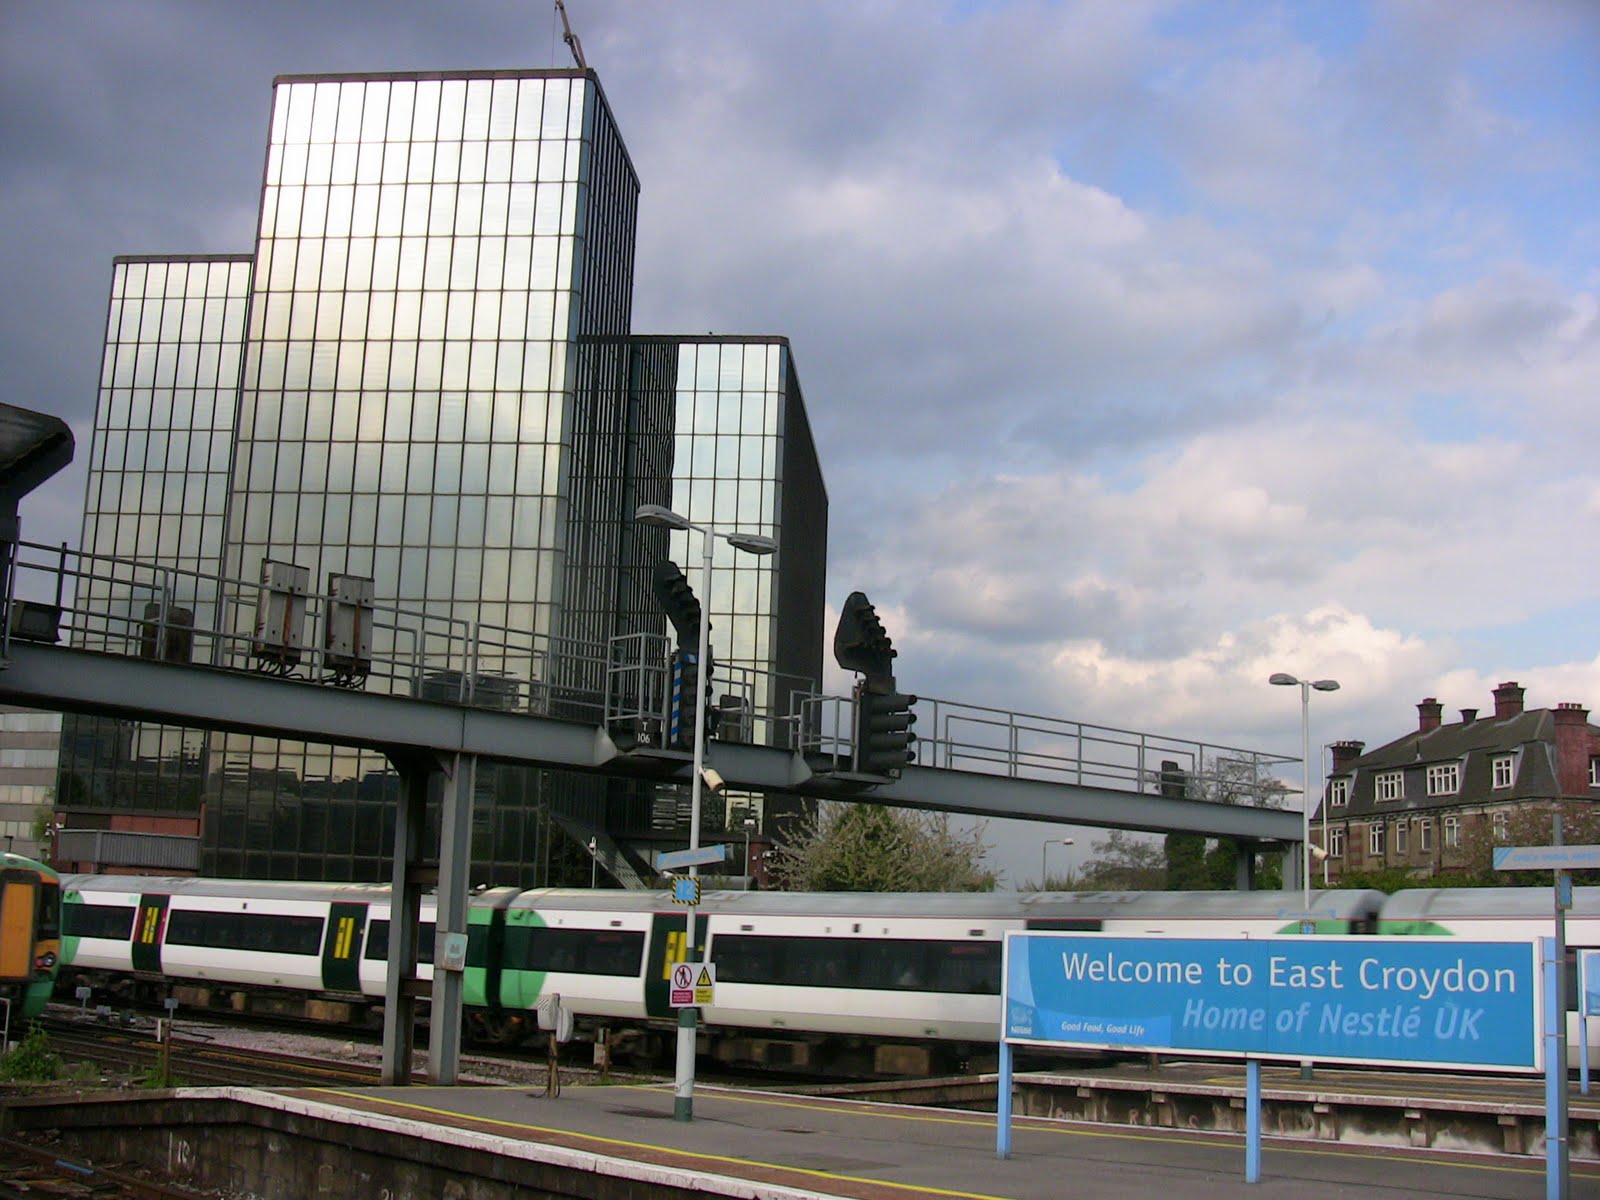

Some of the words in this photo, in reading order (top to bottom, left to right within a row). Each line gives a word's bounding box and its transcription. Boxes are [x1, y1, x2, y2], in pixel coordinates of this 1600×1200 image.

[637, 732, 651, 744] 106
[1062, 951, 1202, 985] Welcome
[1217, 957, 1252, 986] to
[1269, 957, 1344, 988] East
[1359, 958, 1516, 999] Croydon
[1061, 1021, 1081, 1032] Good
[1083, 1022, 1104, 1033] Food,
[1107, 1023, 1127, 1034] Good
[1129, 1024, 1145, 1036] Life
[1182, 999, 1266, 1031] Home
[1276, 1002, 1311, 1032] of
[1319, 1003, 1421, 1038] Nestlé
[1433, 1006, 1485, 1040] UK
